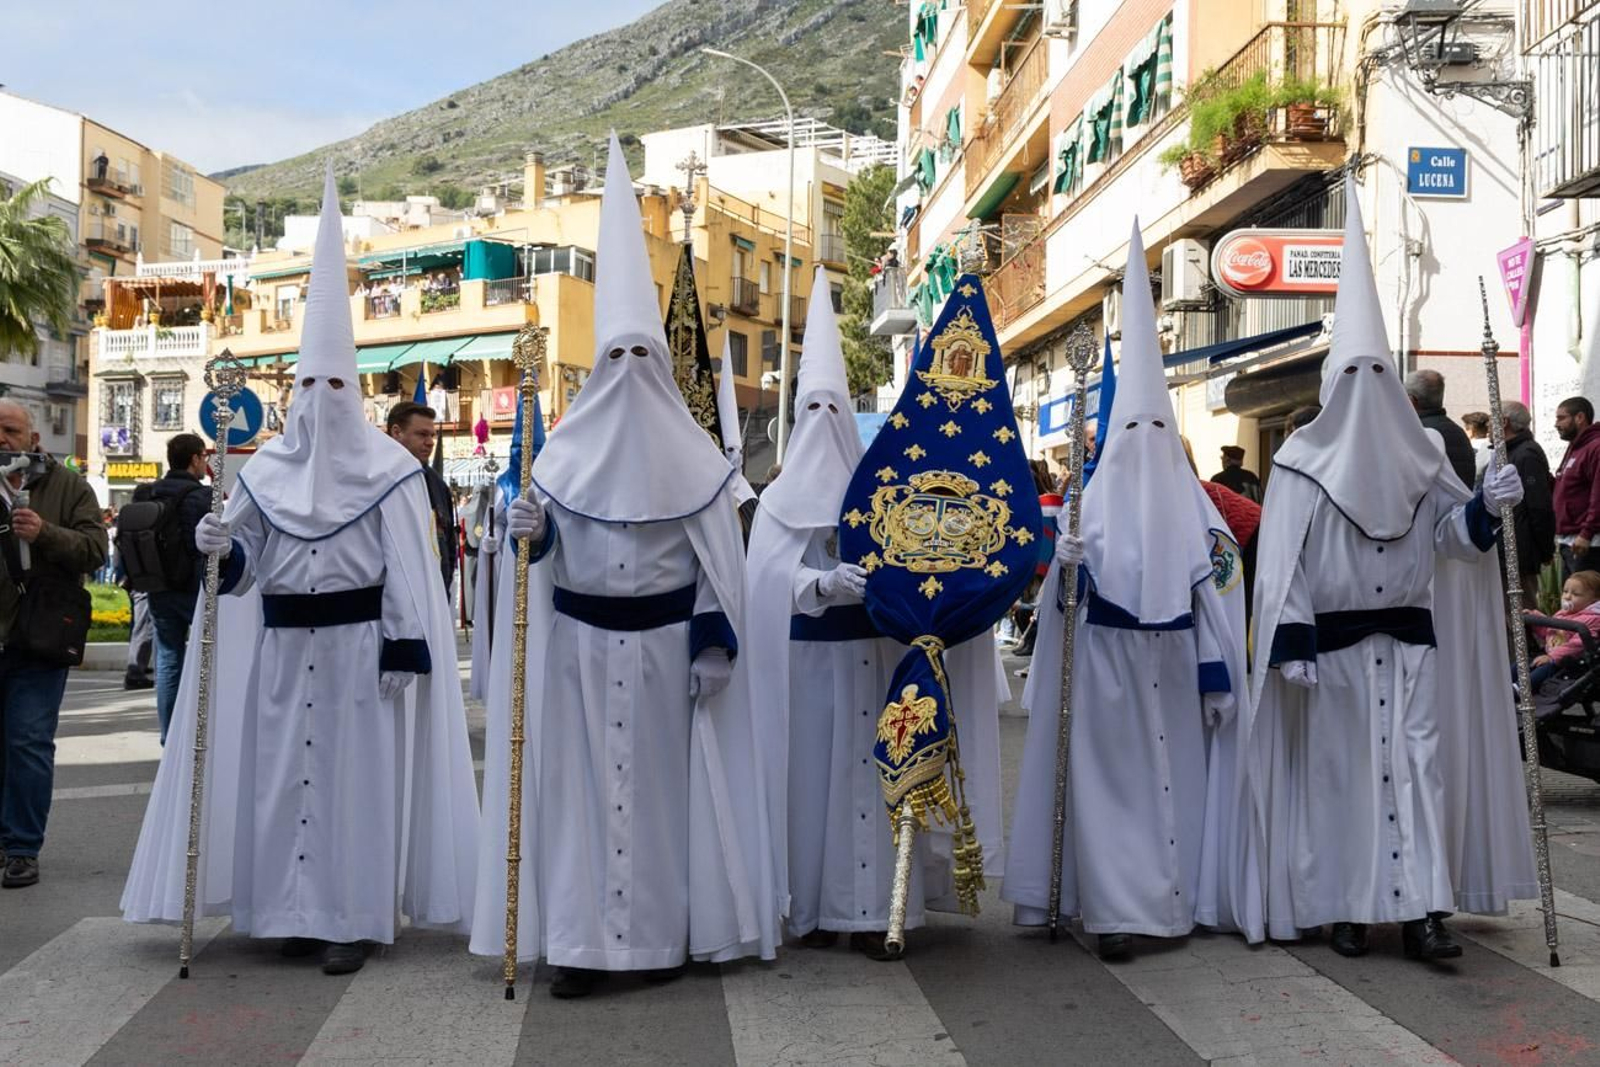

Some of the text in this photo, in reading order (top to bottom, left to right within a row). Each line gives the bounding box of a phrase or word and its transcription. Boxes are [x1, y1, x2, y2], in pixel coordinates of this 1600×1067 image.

[1430, 156, 1456, 167] Calle
[1419, 173, 1454, 187] LUCENA
[1222, 248, 1270, 268] Coca-Cola
[1289, 260, 1341, 279] LAS MERCEDES
